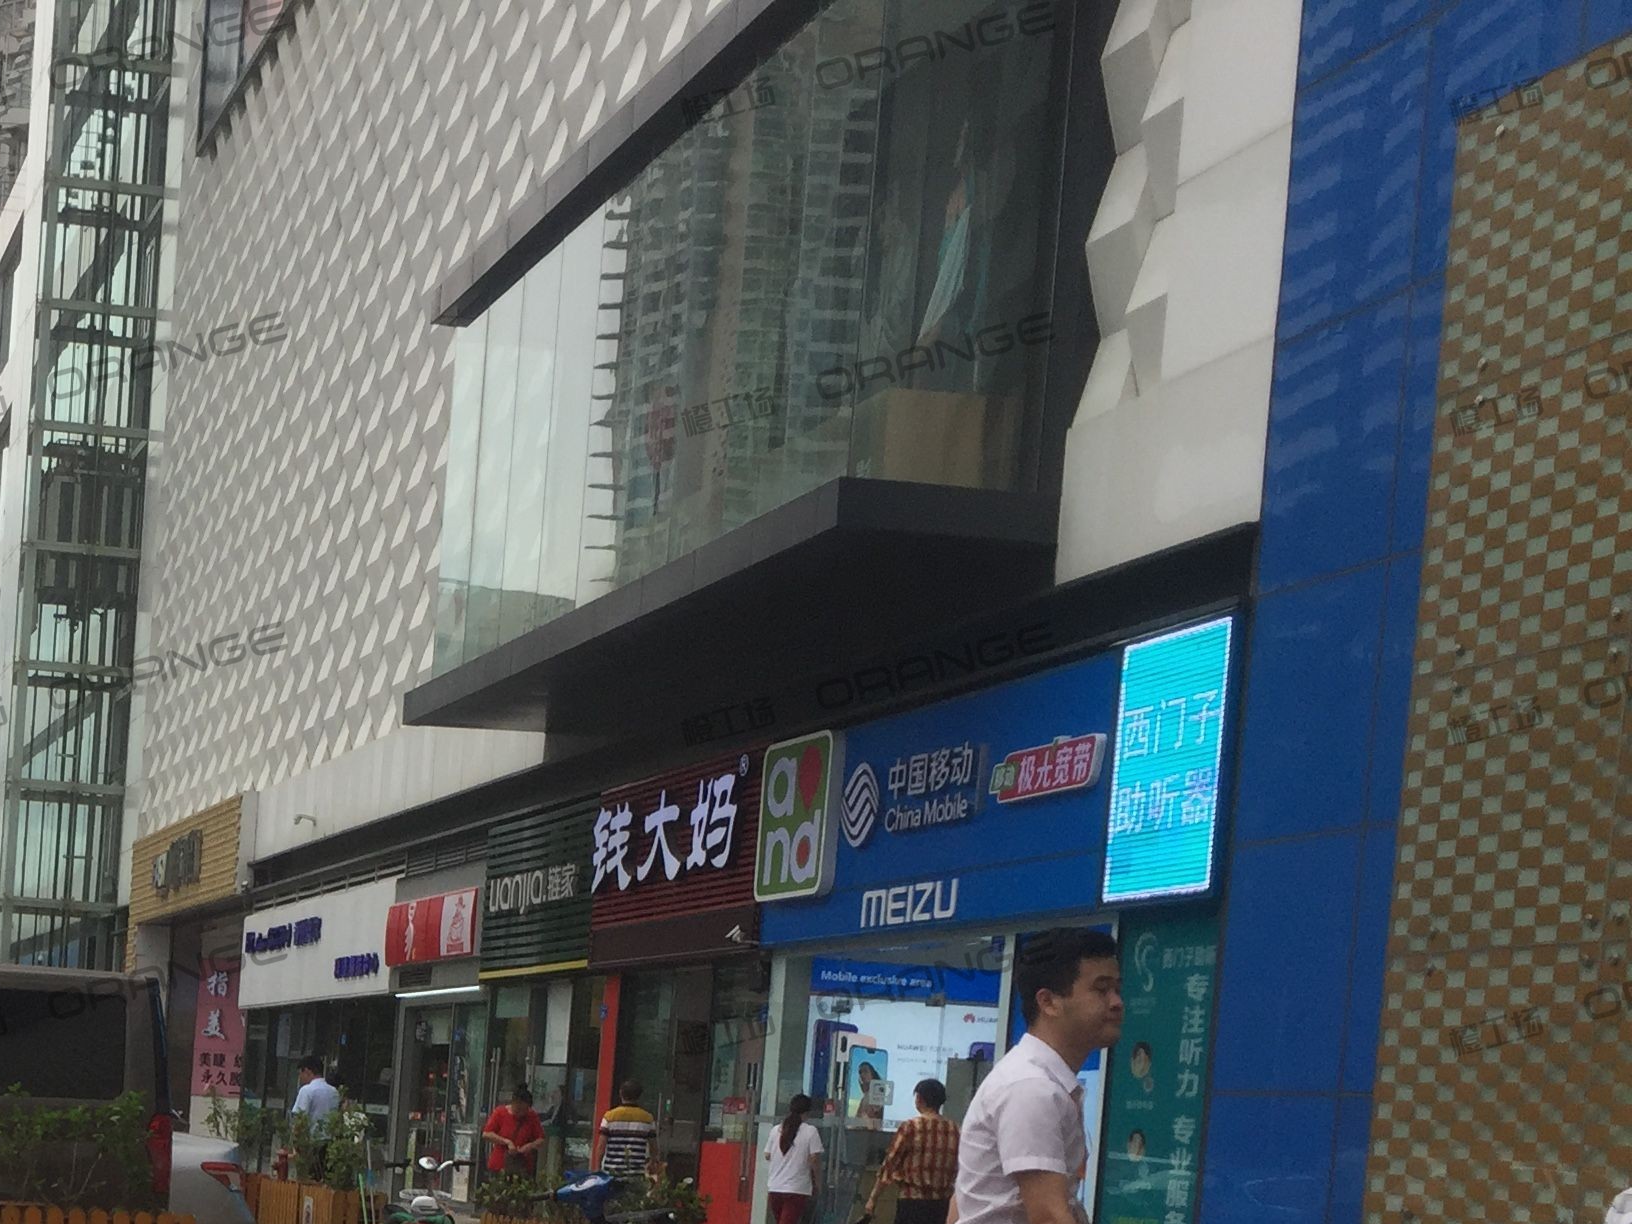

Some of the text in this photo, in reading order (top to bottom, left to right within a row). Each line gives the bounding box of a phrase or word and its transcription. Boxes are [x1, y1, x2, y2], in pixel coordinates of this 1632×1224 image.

[1123, 689, 1220, 760] 西门子
[888, 741, 973, 800] 中国移动
[1114, 768, 1214, 834] 助听器
[592, 773, 738, 892] 钱大妈
[884, 791, 968, 832] China Mobile
[860, 878, 959, 929] MEIZU
[821, 970, 857, 983] Mobile
[1175, 973, 1209, 1098] 专注听力
